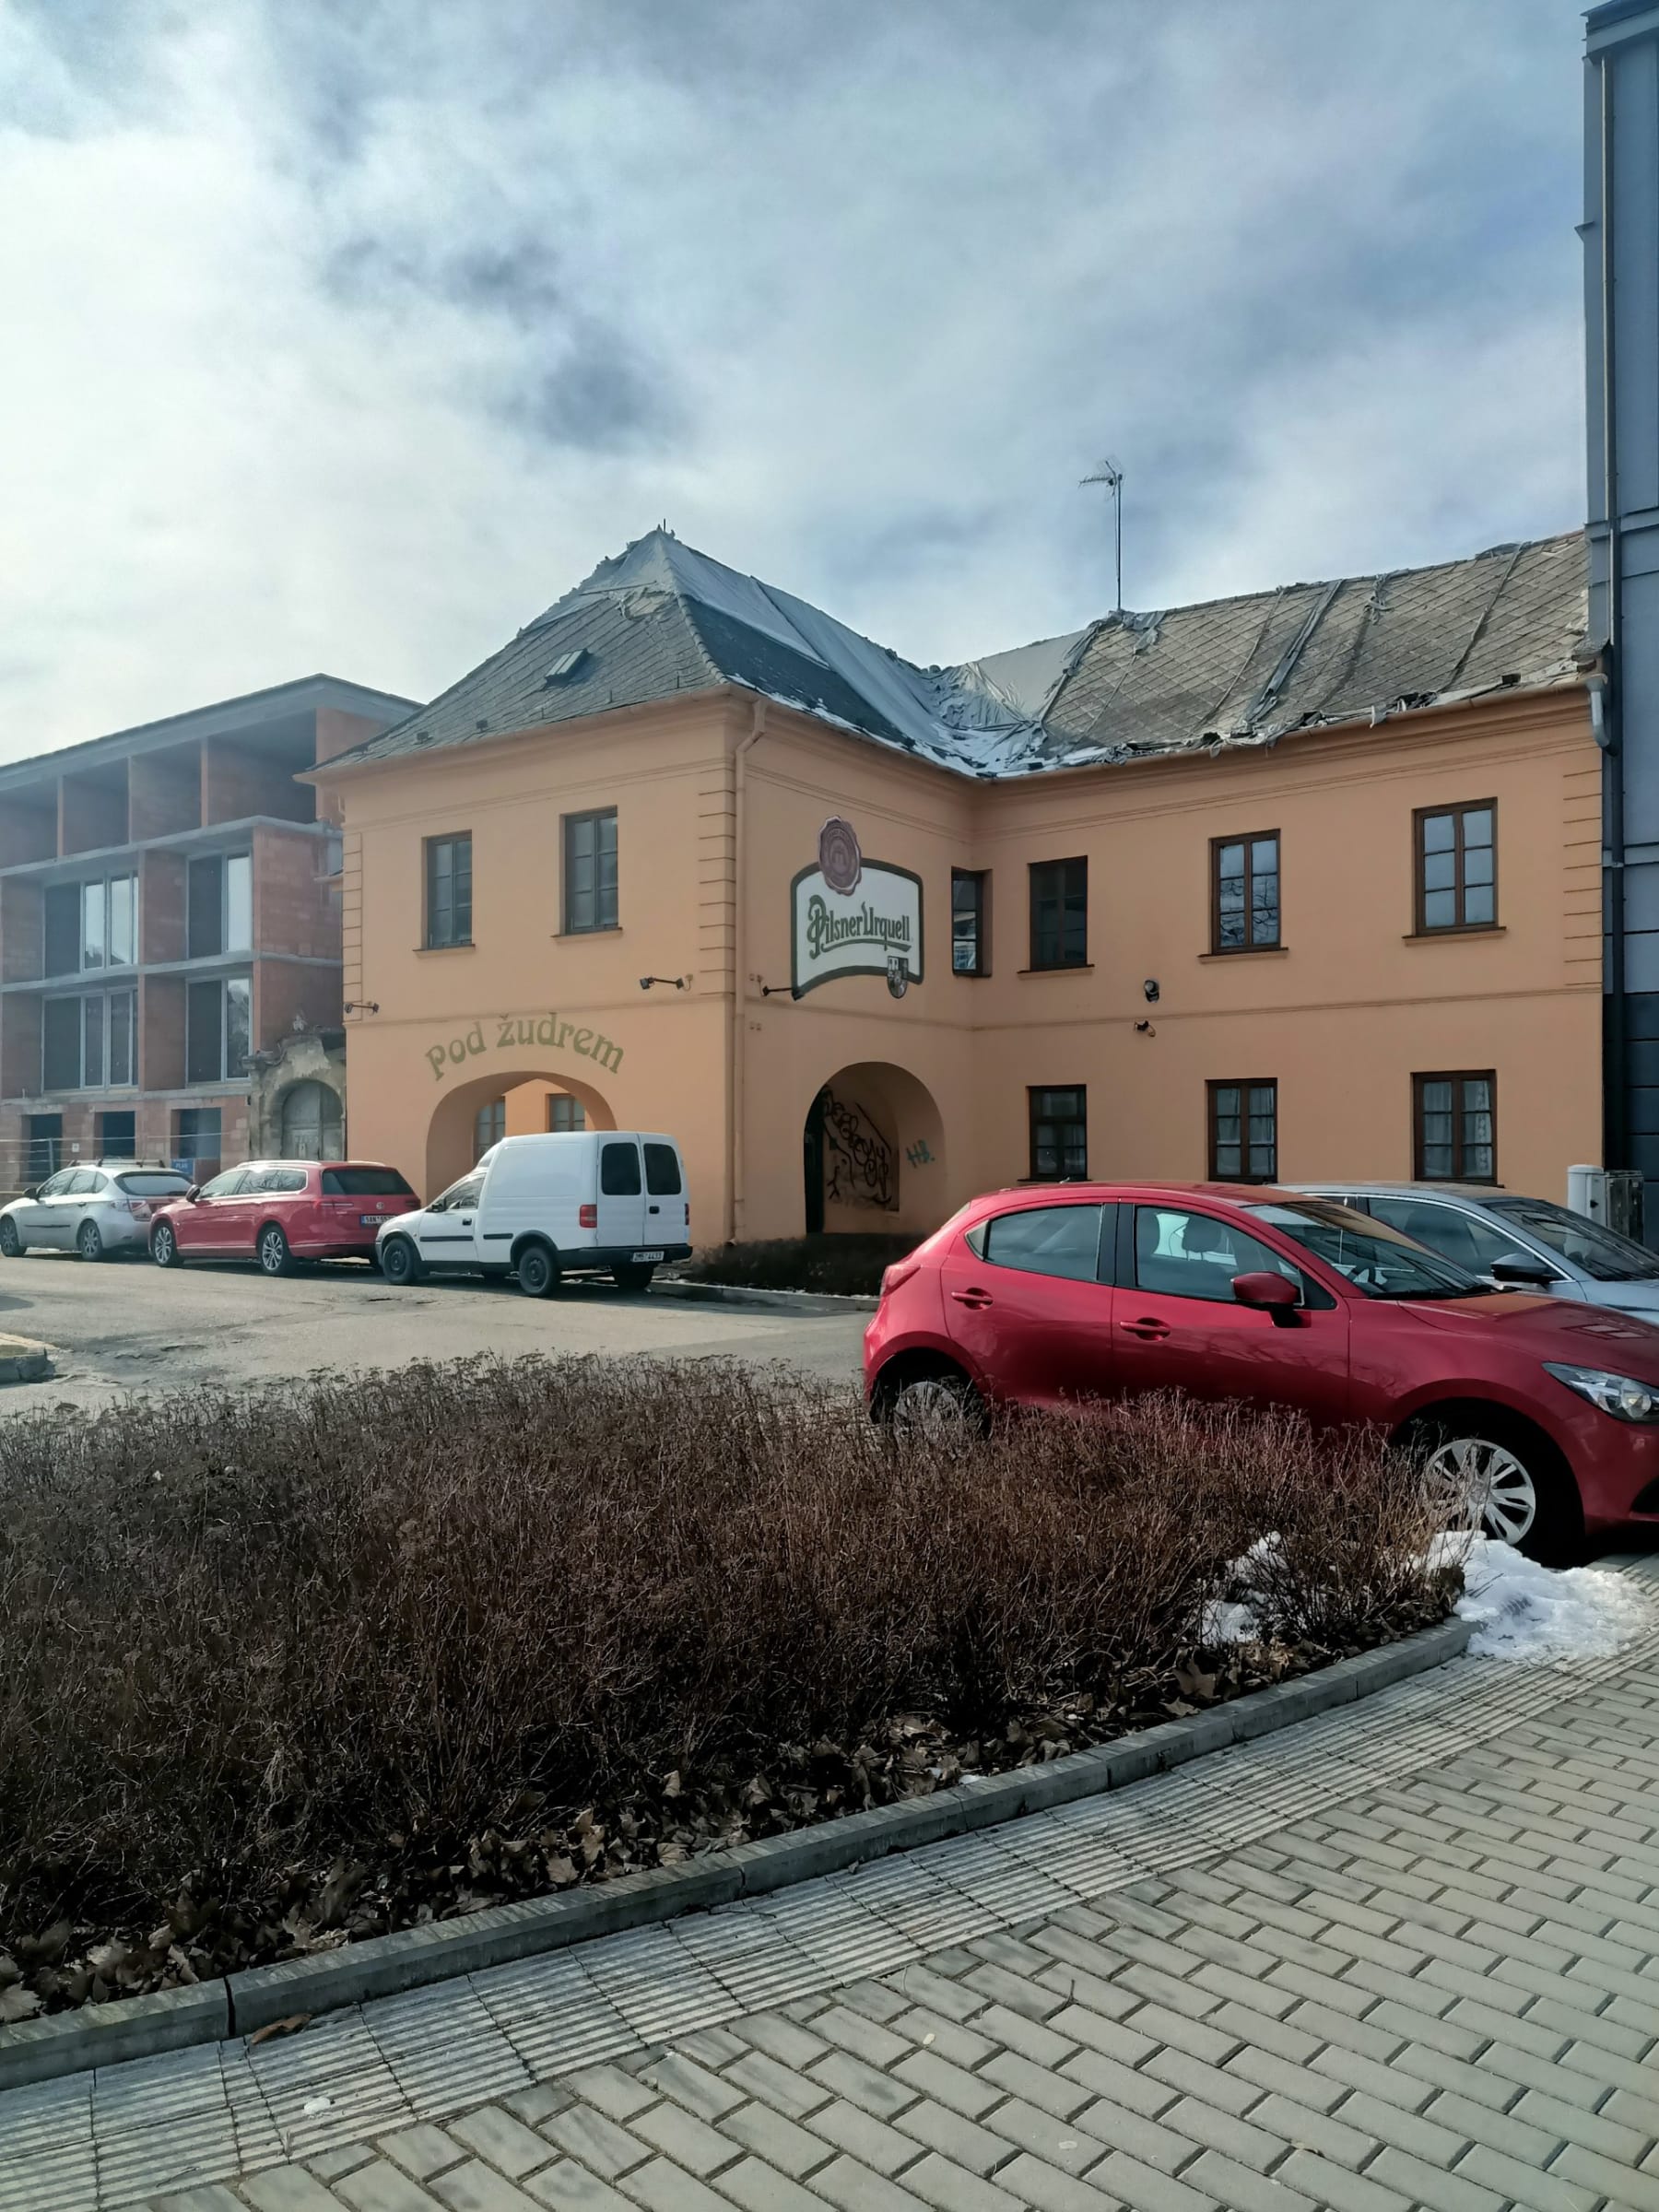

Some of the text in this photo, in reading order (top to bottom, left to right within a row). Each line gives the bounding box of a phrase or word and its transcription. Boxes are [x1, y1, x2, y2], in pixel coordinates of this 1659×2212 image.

[806, 895, 910, 959] Pilsner Urquell
[497, 1012, 624, 1074] žudrem
